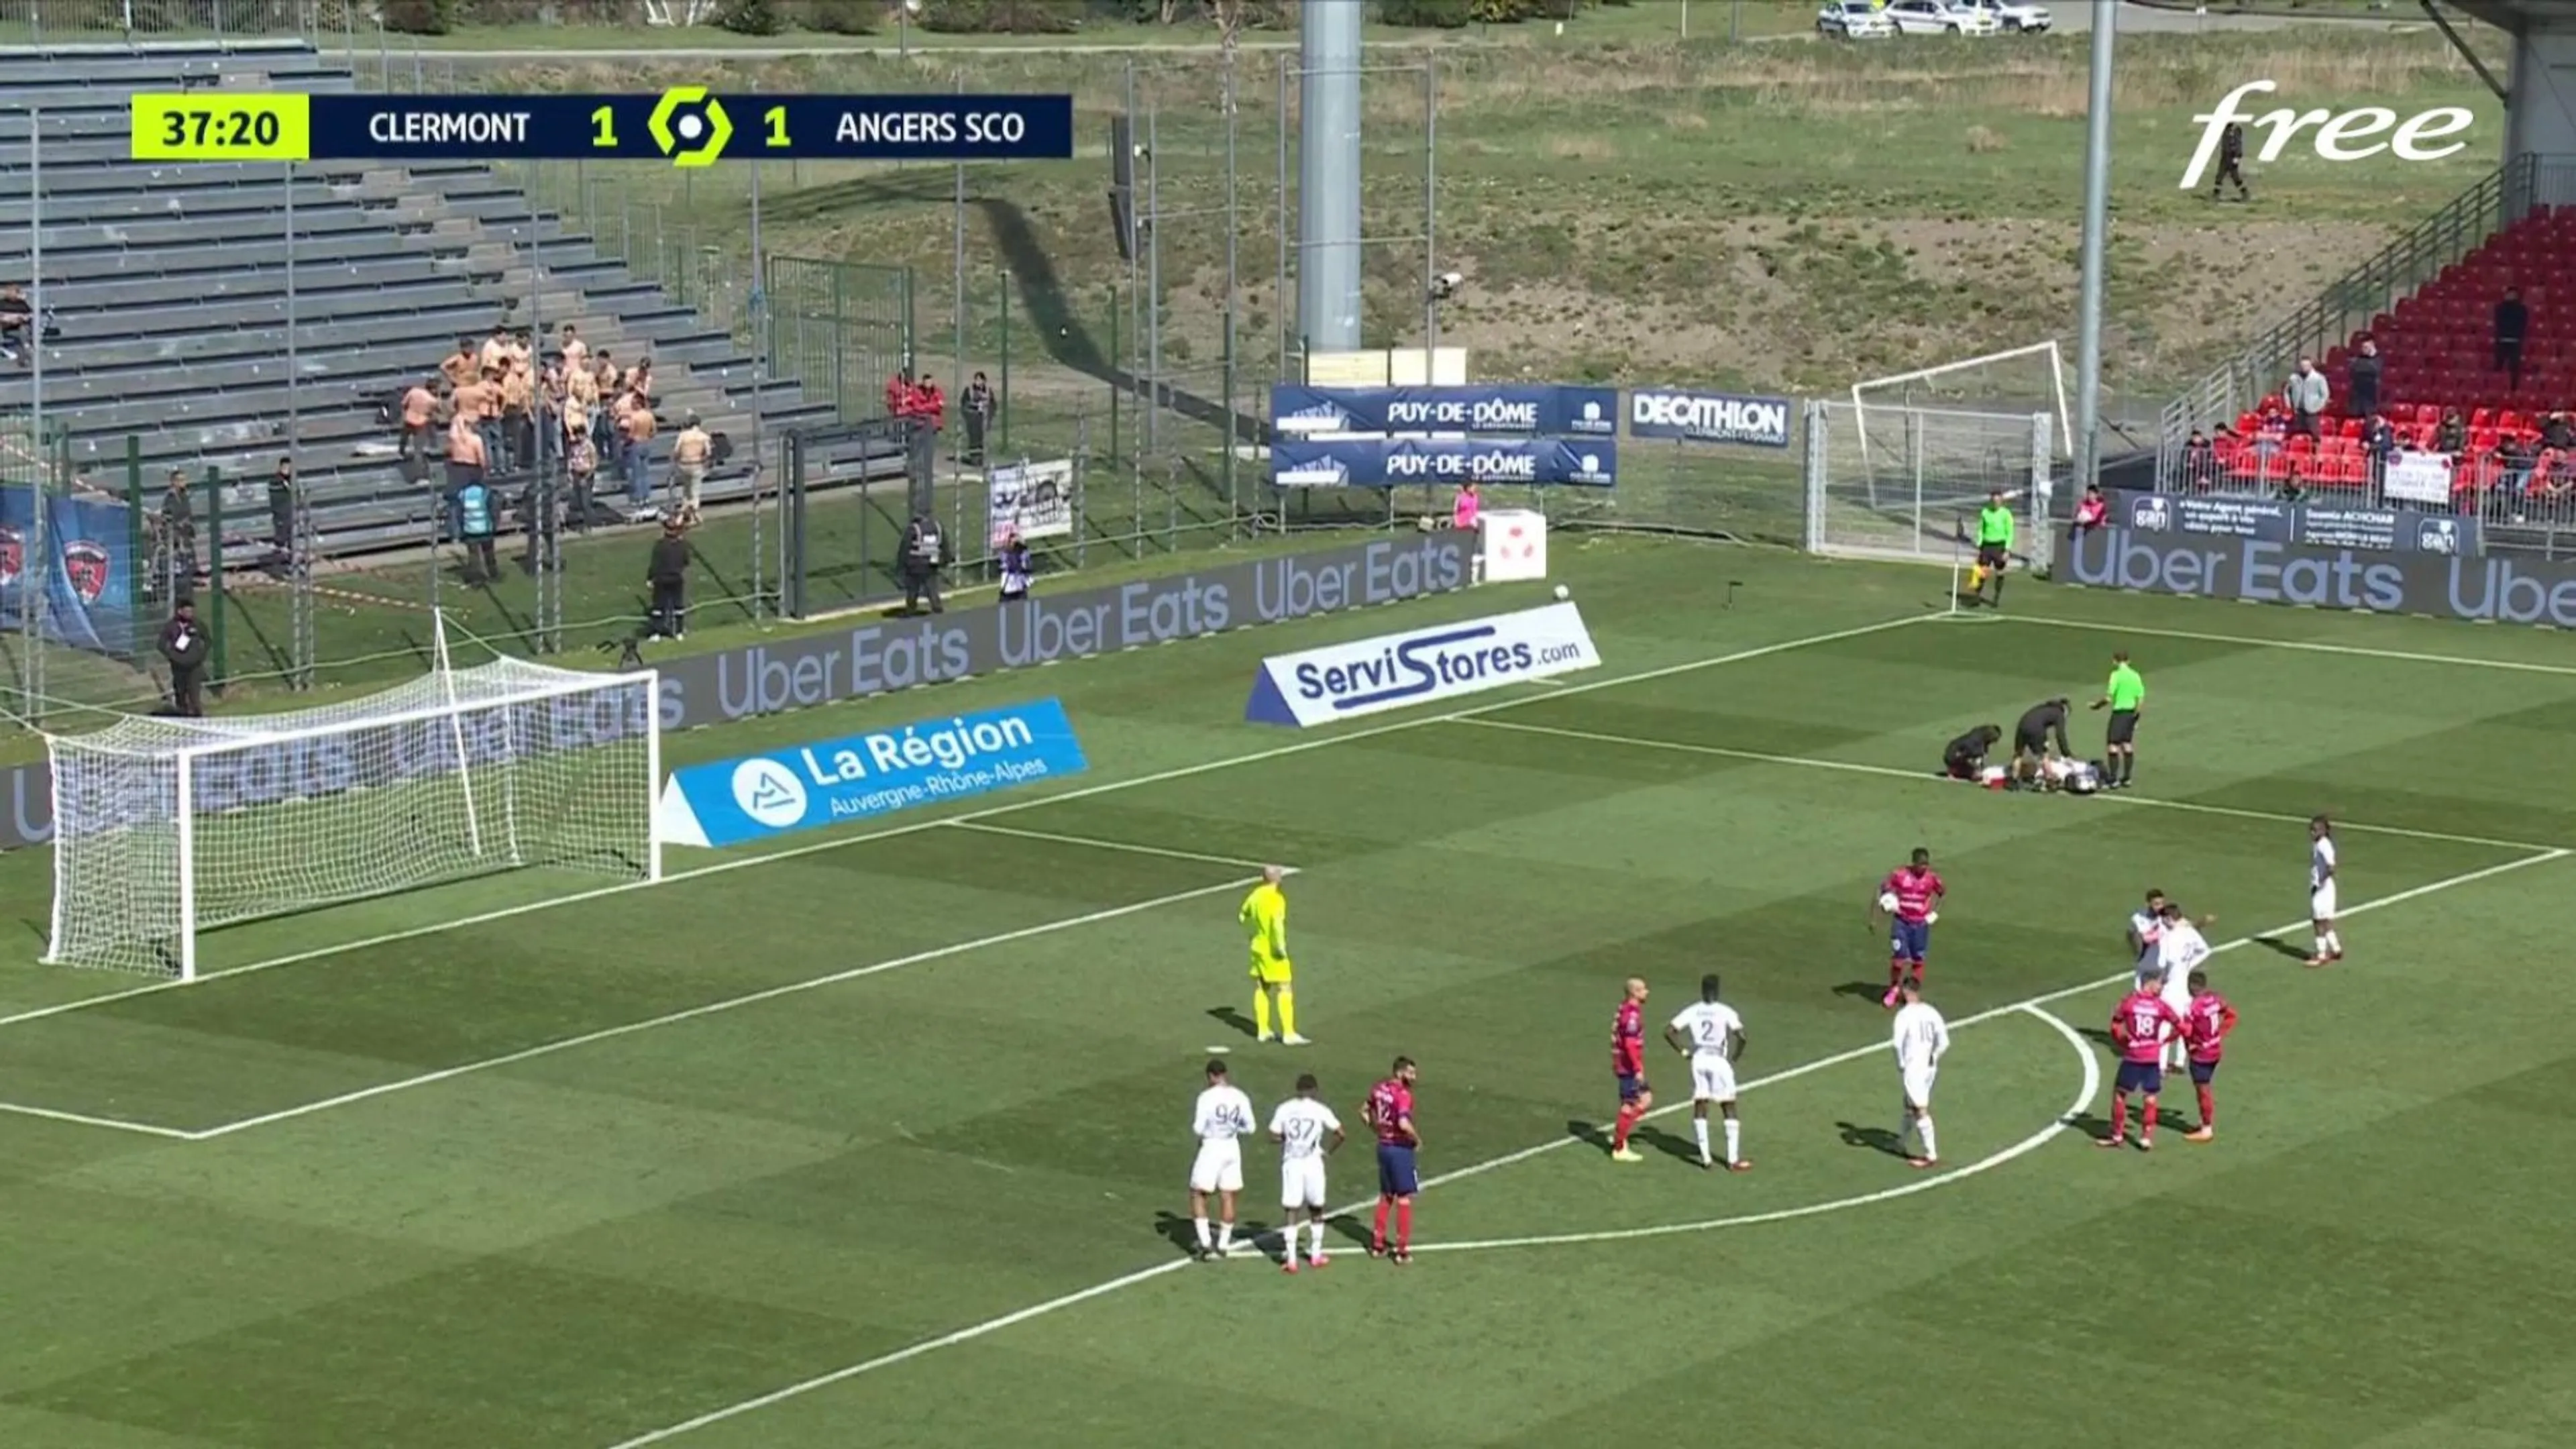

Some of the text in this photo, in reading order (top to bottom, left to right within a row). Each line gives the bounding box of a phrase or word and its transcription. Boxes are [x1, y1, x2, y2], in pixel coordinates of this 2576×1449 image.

[1633, 394, 1786, 434] DECATHLON
[1256, 537, 1460, 621] Uber Eats
[2073, 527, 2403, 610] Uber Eats
[1000, 577, 1230, 666] Uber Eats
[718, 622, 969, 718] Uber Eats
[800, 716, 1034, 786] La Région
[830, 757, 1048, 816] Auvergne-Rhône-Alpes
[1701, 1020, 1715, 1041] 2
[2135, 1014, 2154, 1037] 18
[1215, 1104, 1240, 1125] 94
[1288, 1117, 1315, 1140] 37
